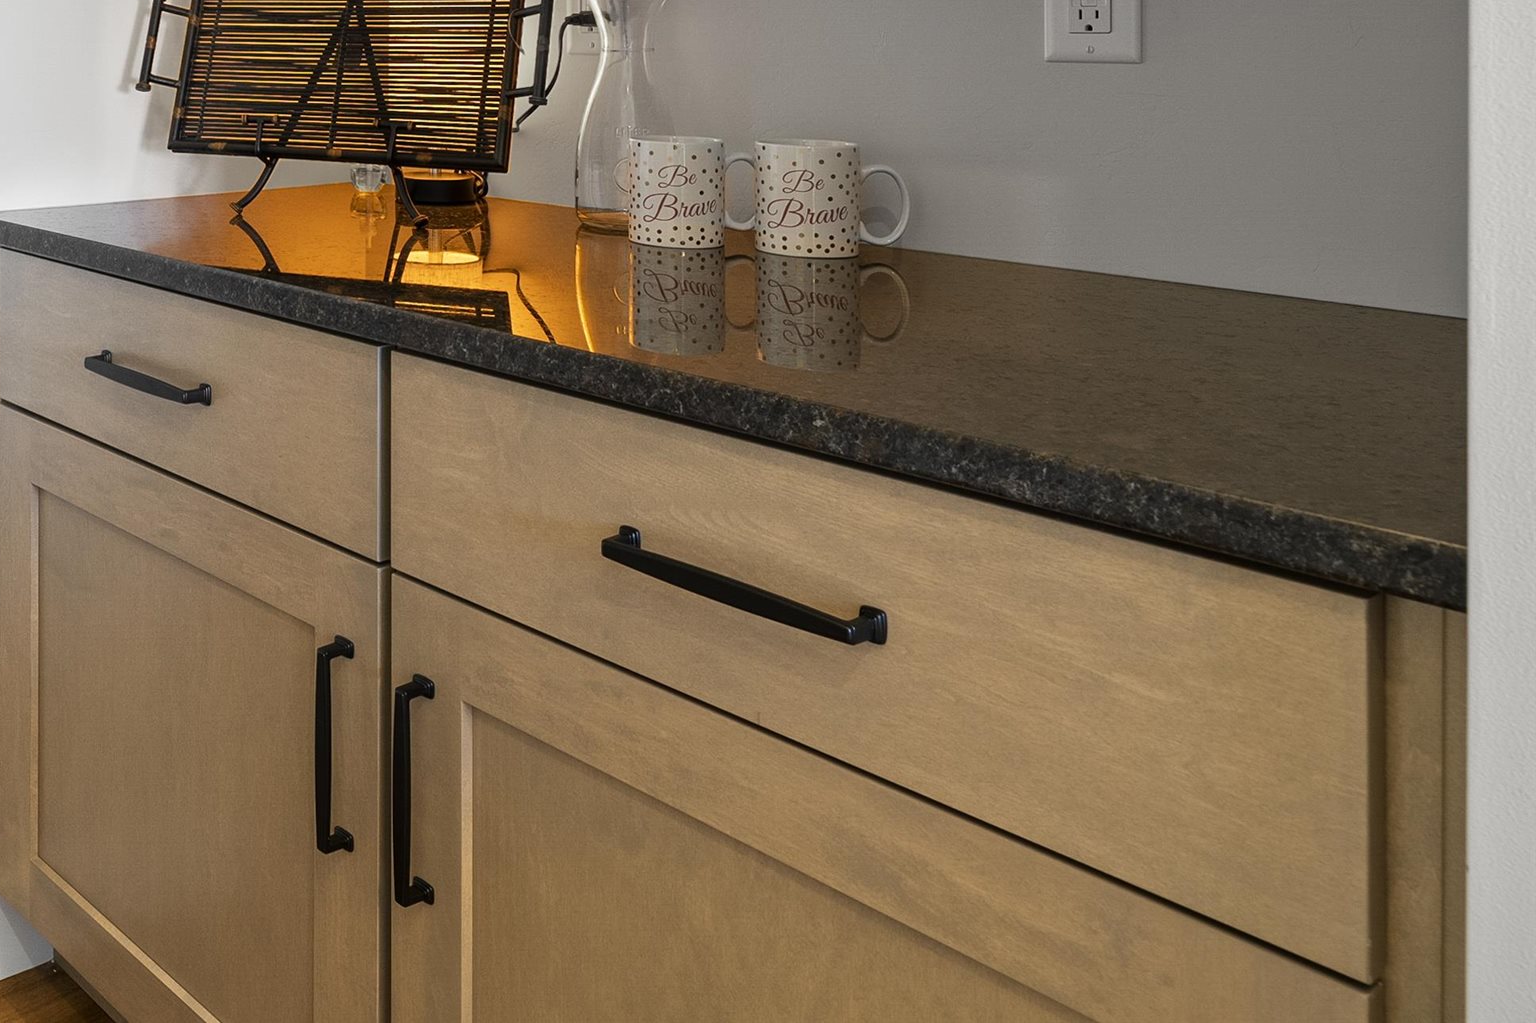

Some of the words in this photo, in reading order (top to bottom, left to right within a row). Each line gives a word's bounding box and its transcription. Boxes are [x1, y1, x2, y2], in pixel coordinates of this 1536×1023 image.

[658, 164, 697, 188] Be
[782, 169, 825, 194] Be
[642, 192, 717, 222] Brave
[767, 198, 848, 229] Brave
